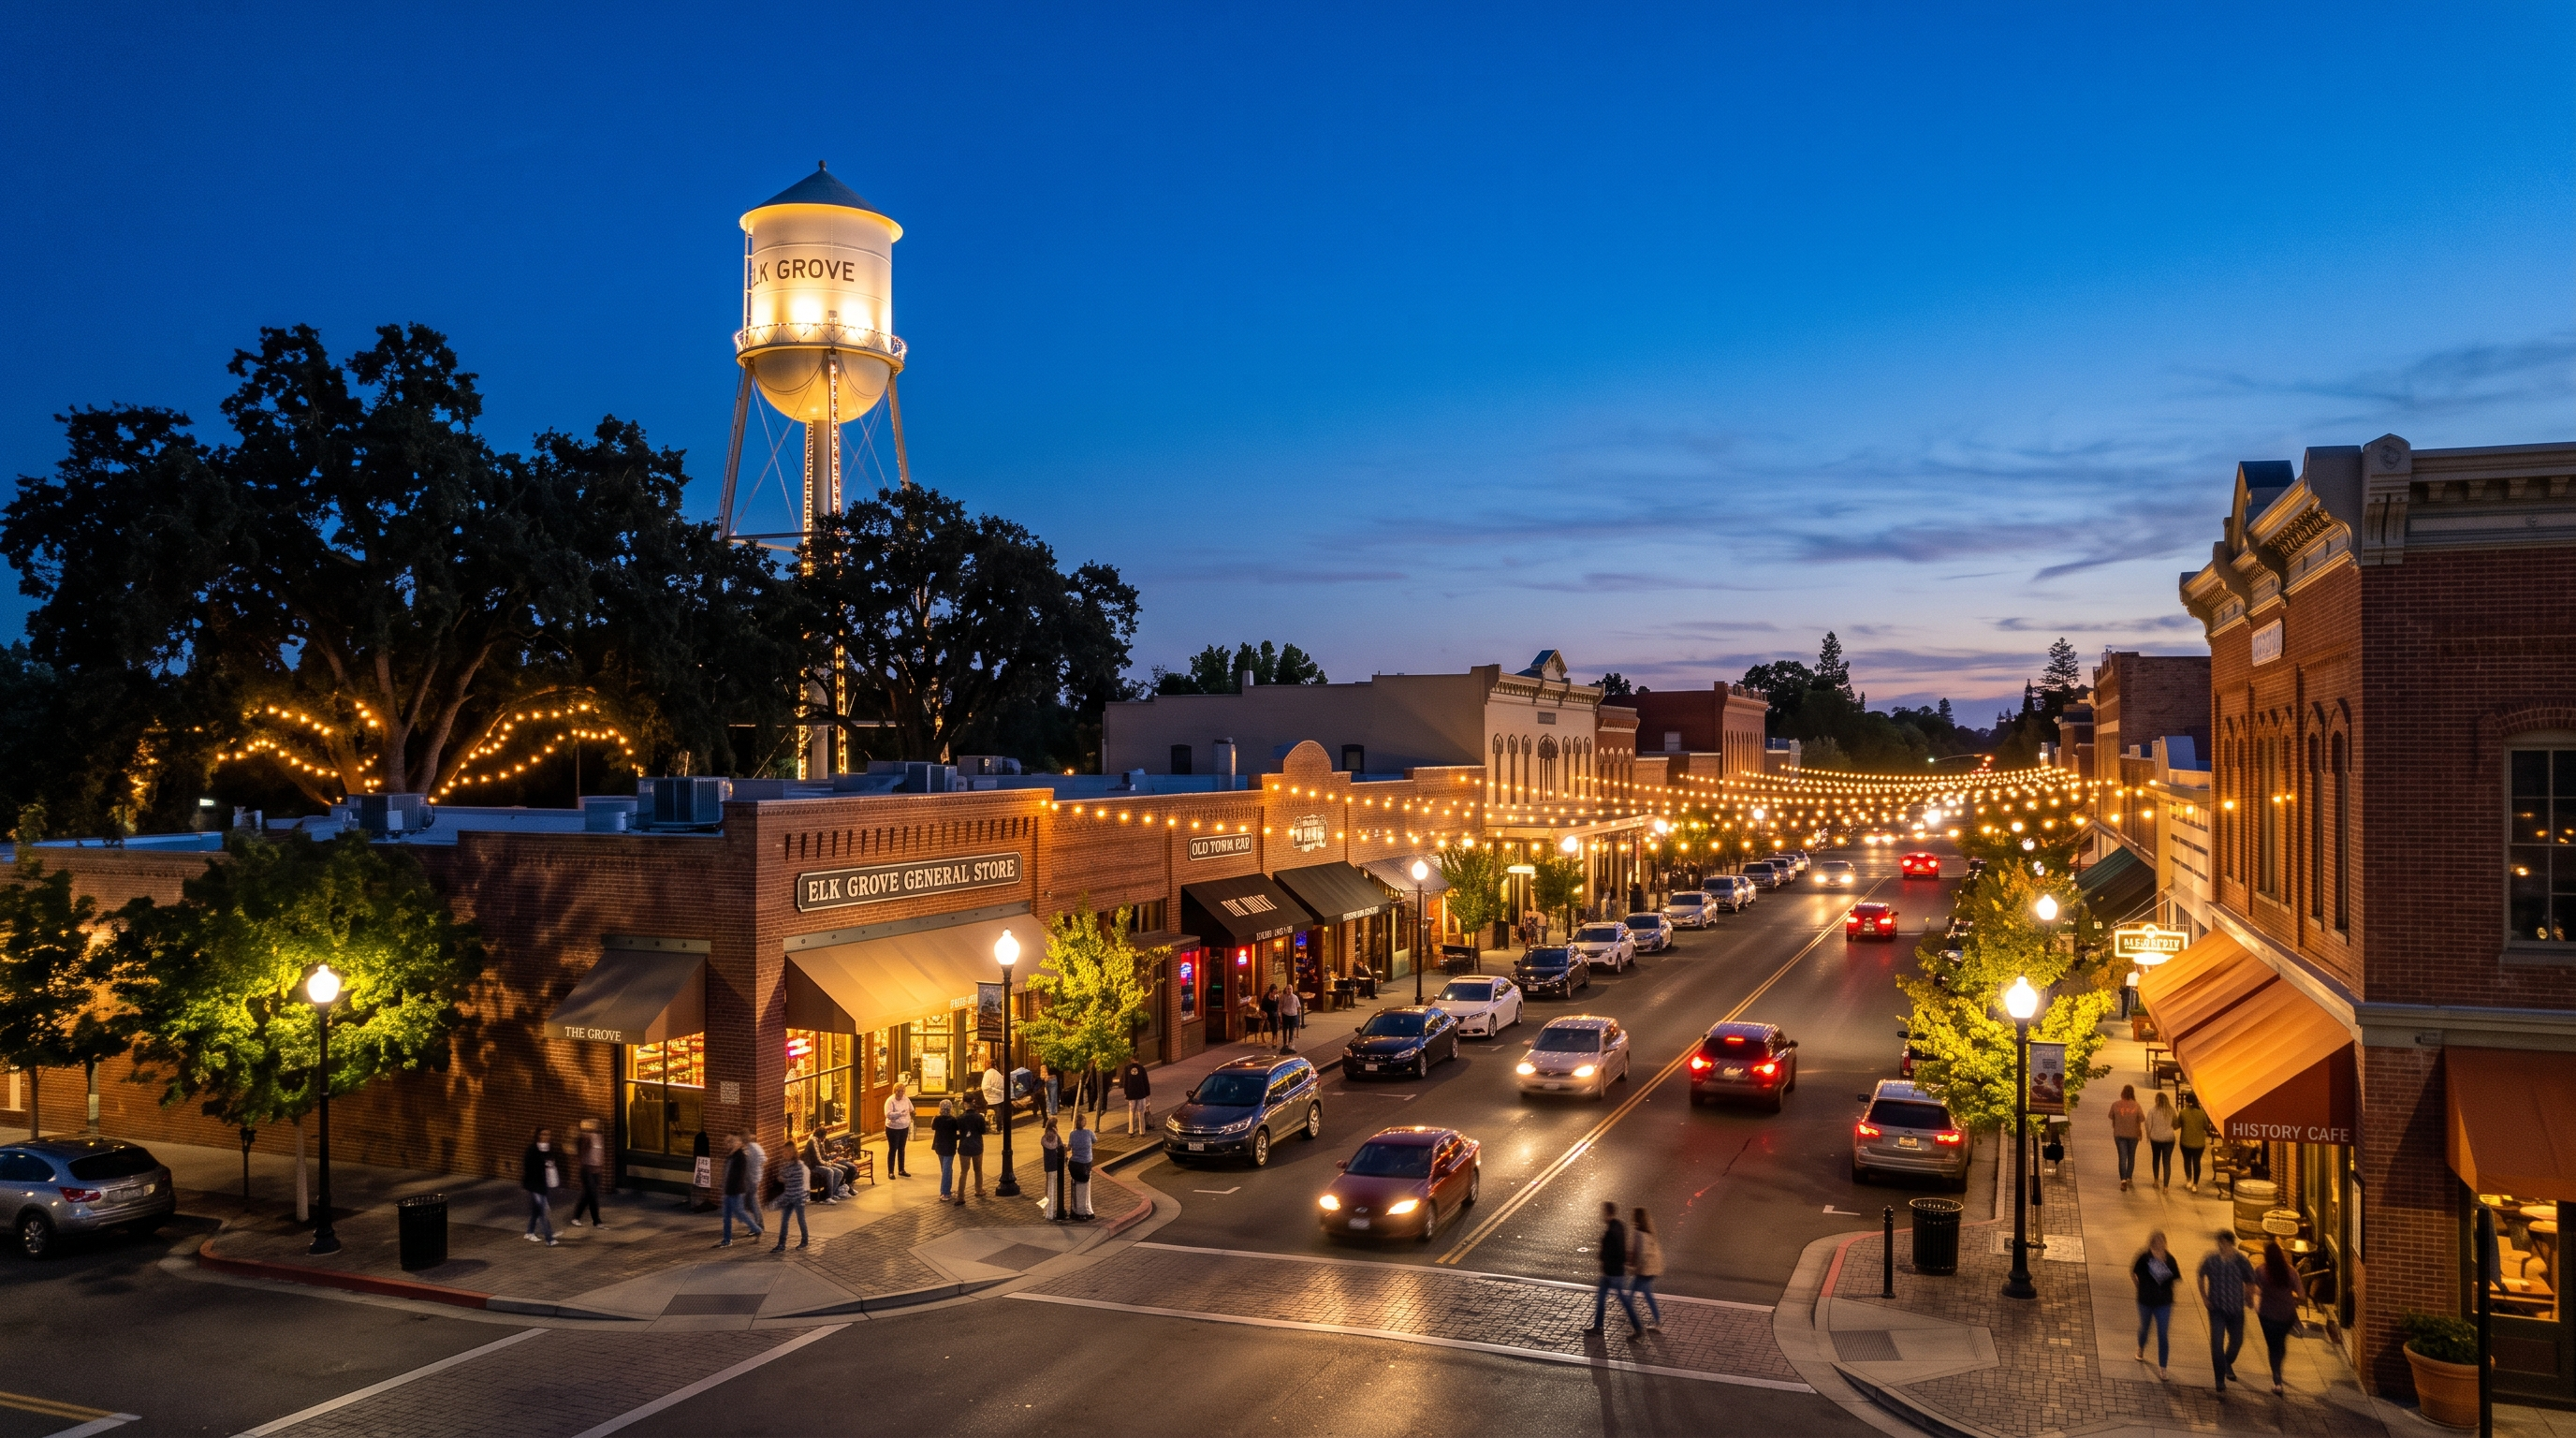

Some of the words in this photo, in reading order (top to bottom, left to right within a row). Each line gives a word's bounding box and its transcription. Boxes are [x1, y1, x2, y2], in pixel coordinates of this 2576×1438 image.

[753, 262, 768, 288] LK
[777, 258, 856, 283] GROVE
[1192, 842, 1208, 856] OLD
[807, 877, 842, 902] ELK
[846, 872, 900, 898] GROVE
[903, 864, 970, 890] GENERAL
[973, 858, 1016, 882] STORE
[564, 1026, 585, 1038] THE
[587, 1028, 622, 1042] GROVE
[2232, 1123, 2302, 1139] HISTORY
[2307, 1126, 2349, 1142] CAFE
